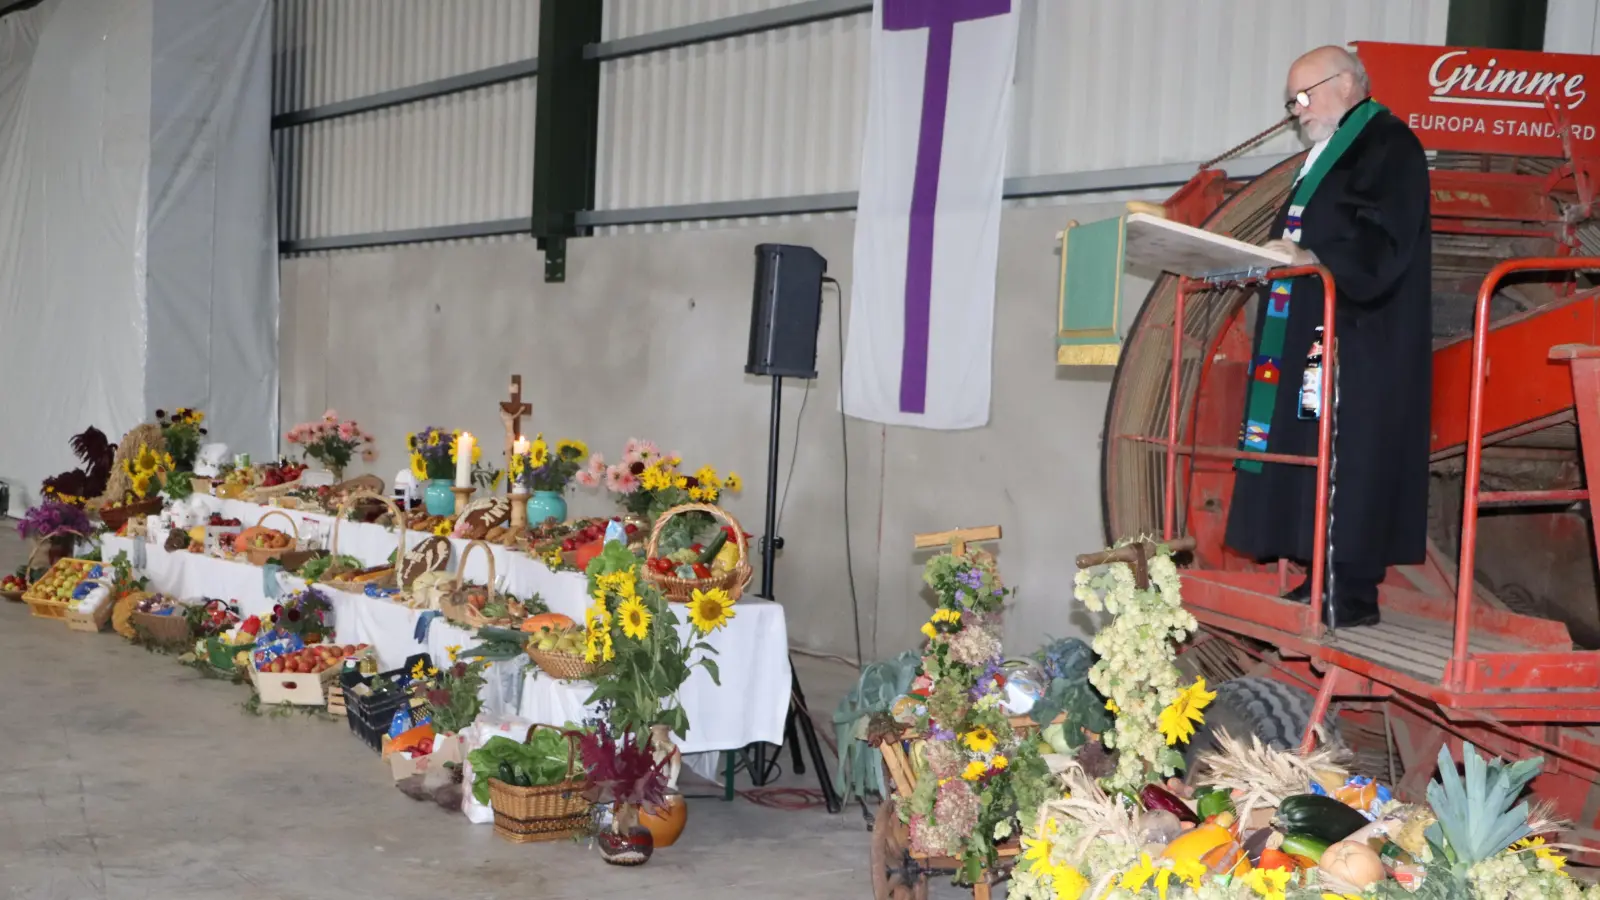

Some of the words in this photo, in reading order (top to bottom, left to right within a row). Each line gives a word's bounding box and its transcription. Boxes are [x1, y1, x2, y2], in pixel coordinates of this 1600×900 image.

[1428, 50, 1586, 109] Grimme
[1408, 113, 1486, 133] EUROPA
[1493, 119, 1596, 141] STANDRD
